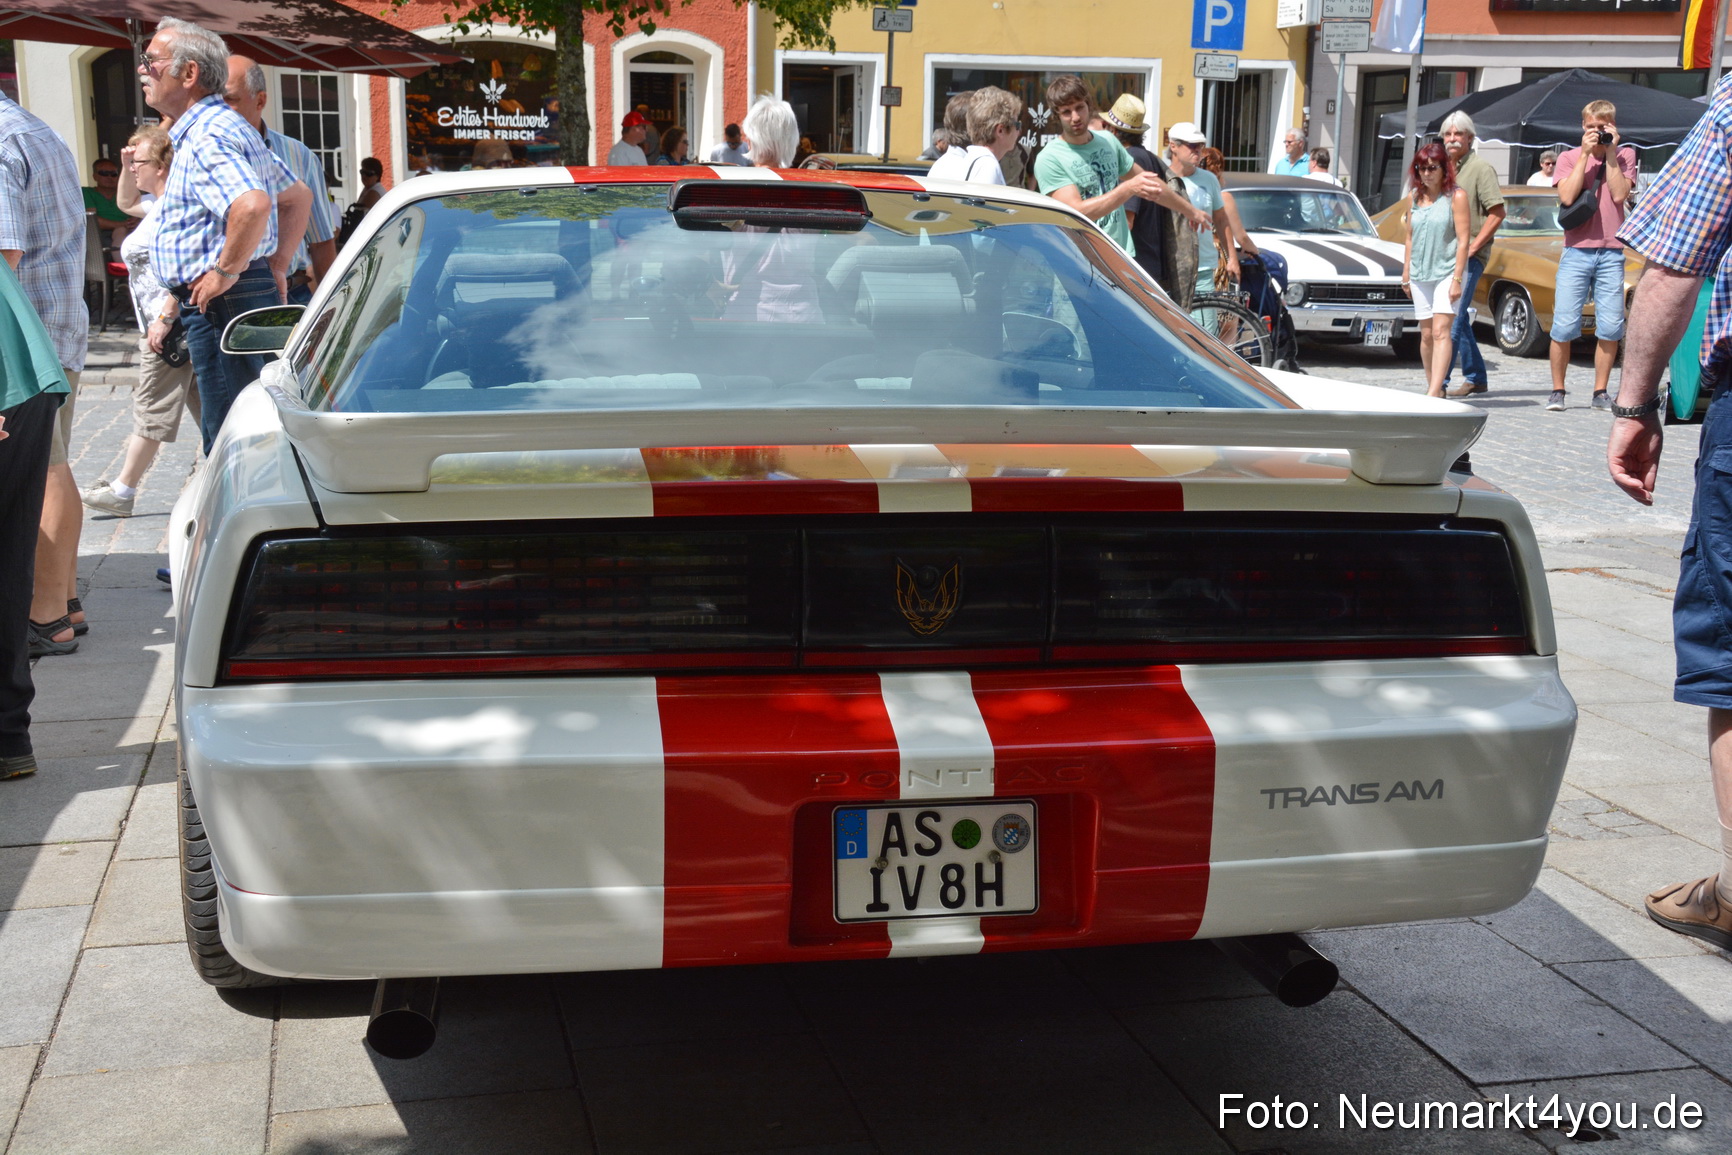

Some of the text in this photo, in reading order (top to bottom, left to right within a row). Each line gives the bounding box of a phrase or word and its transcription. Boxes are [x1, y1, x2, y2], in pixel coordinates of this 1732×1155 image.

[1325, 5, 1334, 13] Sa
[1204, 0, 1234, 42] P
[1328, 101, 1335, 112] 6
[437, 105, 550, 128] Echtes Handwerk
[454, 128, 535, 141] IMMER FRISCH
[1018, 129, 1038, 149] afé
[1367, 292, 1385, 300] SS
[1372, 322, 1384, 333] NM
[813, 765, 1085, 790] PONTIAC
[1260, 779, 1444, 809] TRANS AM
[880, 811, 943, 858] AS
[846, 840, 858, 856] D
